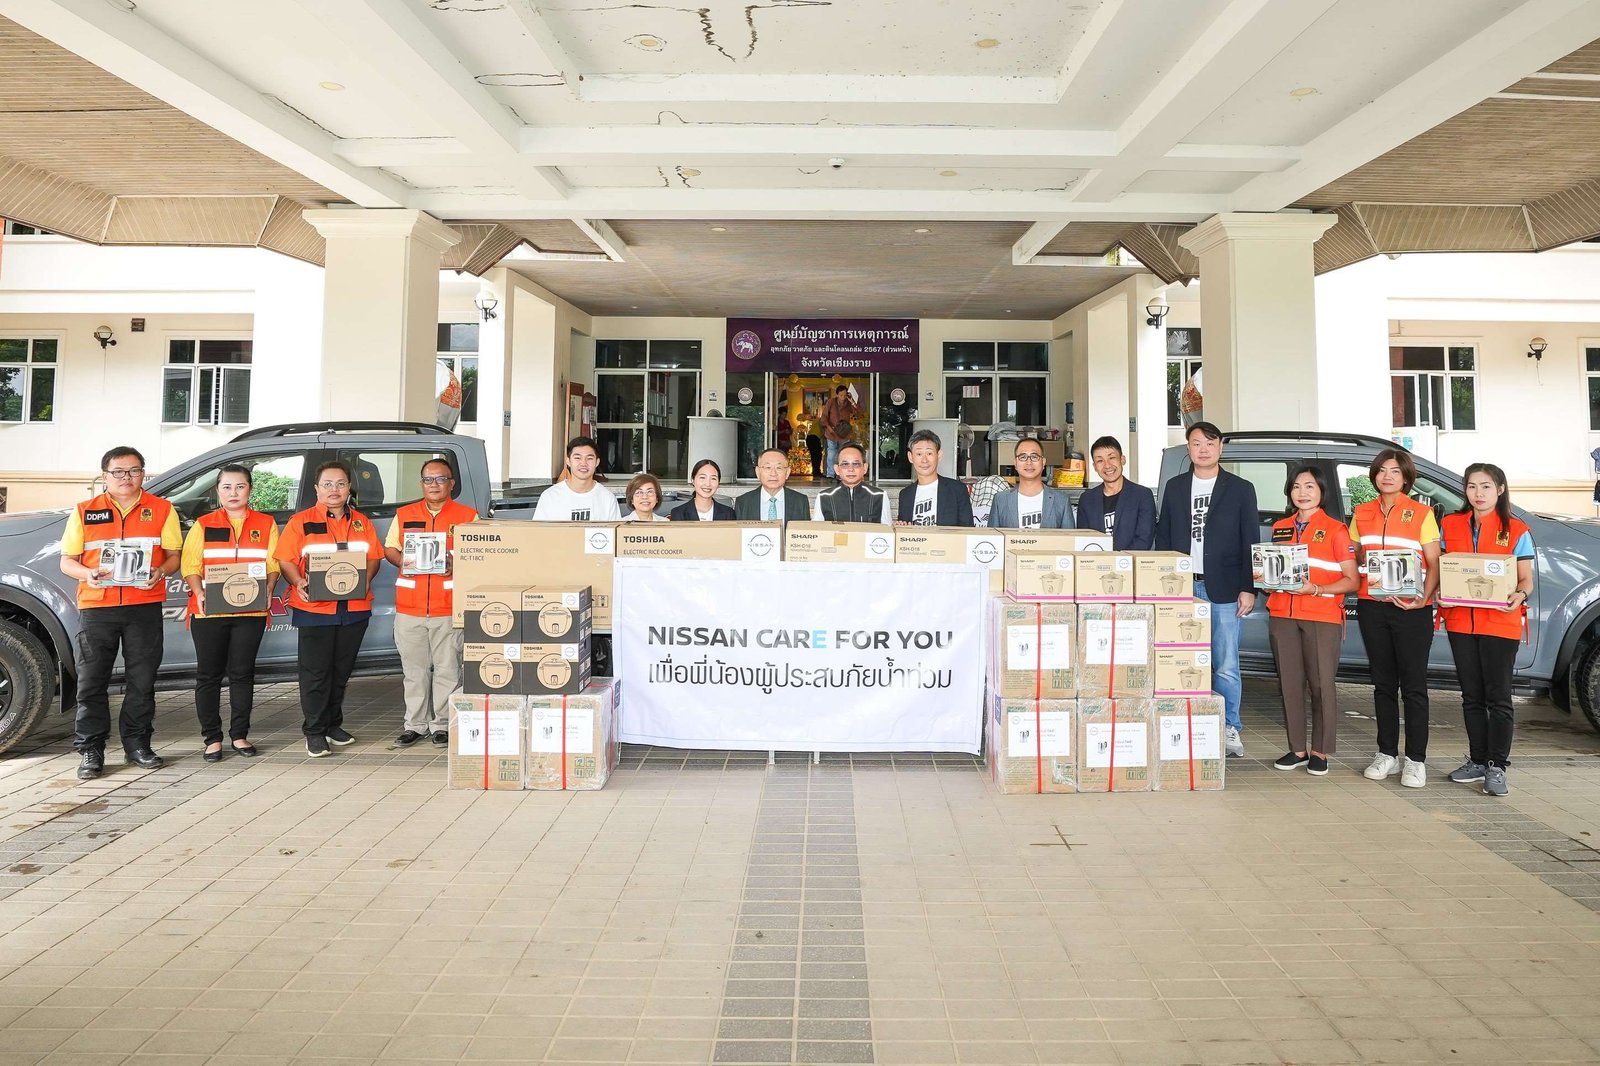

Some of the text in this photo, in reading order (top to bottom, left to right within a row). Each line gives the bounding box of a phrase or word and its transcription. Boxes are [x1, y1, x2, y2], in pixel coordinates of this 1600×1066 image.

[774, 325, 909, 343] ศูนย์บัญชาการเหตุการณ์
[801, 356, 871, 368] จังหวัดเชียงราย
[86, 512, 109, 521] DDPM
[623, 535, 665, 543] TOSHIBA
[648, 626, 952, 650] NISSAN CARE FOR YOU
[649, 654, 952, 694] เพื่อพี่น้องผู้ประสบภัยน้ำท่วม
